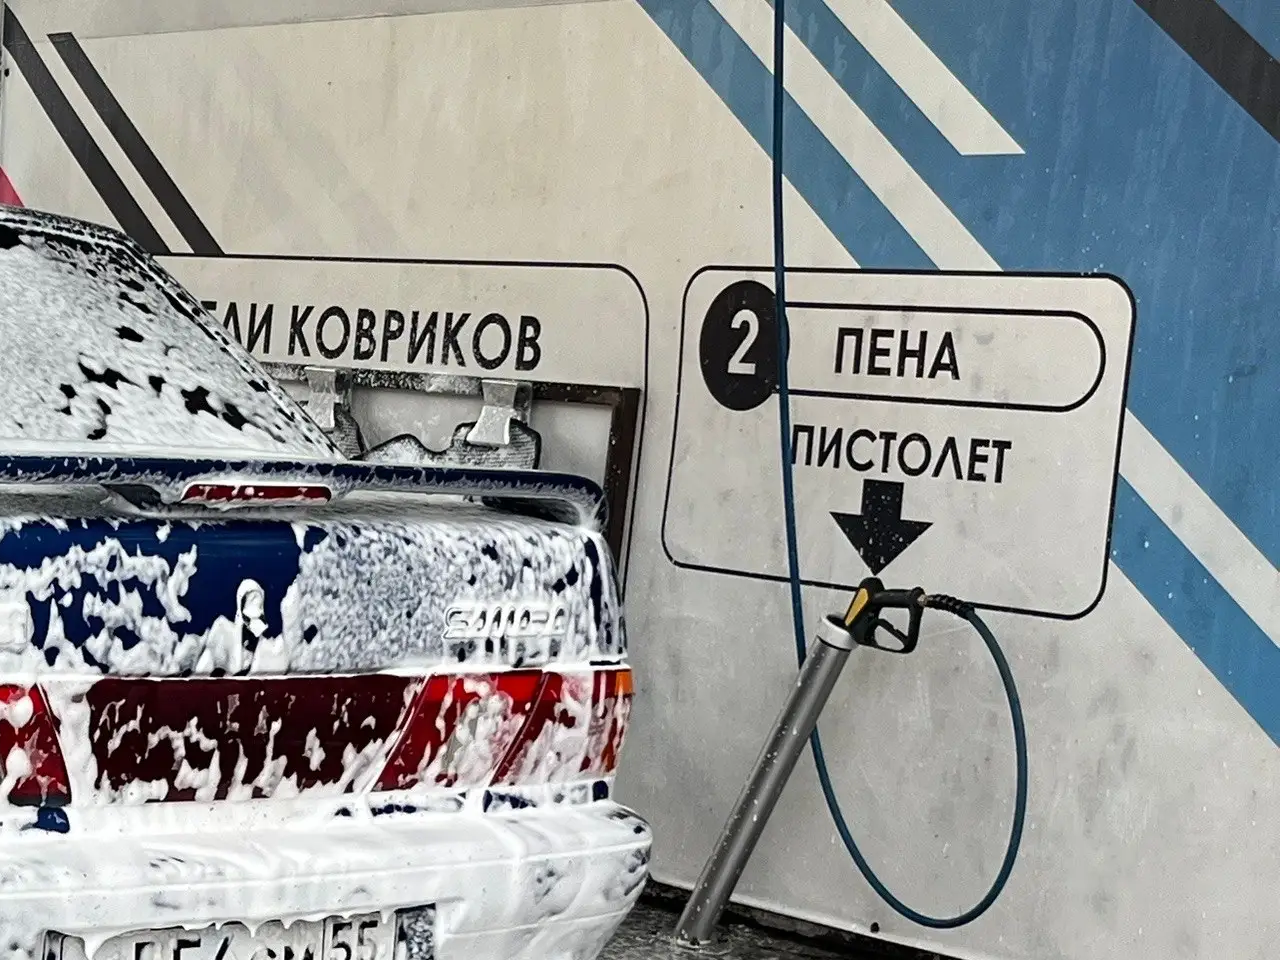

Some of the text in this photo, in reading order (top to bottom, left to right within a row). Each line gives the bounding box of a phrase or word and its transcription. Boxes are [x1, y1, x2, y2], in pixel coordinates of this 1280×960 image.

[200, 300, 542, 372] ЛИ КОВРИКОВ
[727, 309, 961, 381] 2 ПЕНА
[792, 424, 1013, 484] ПИСТОЛЕТ
